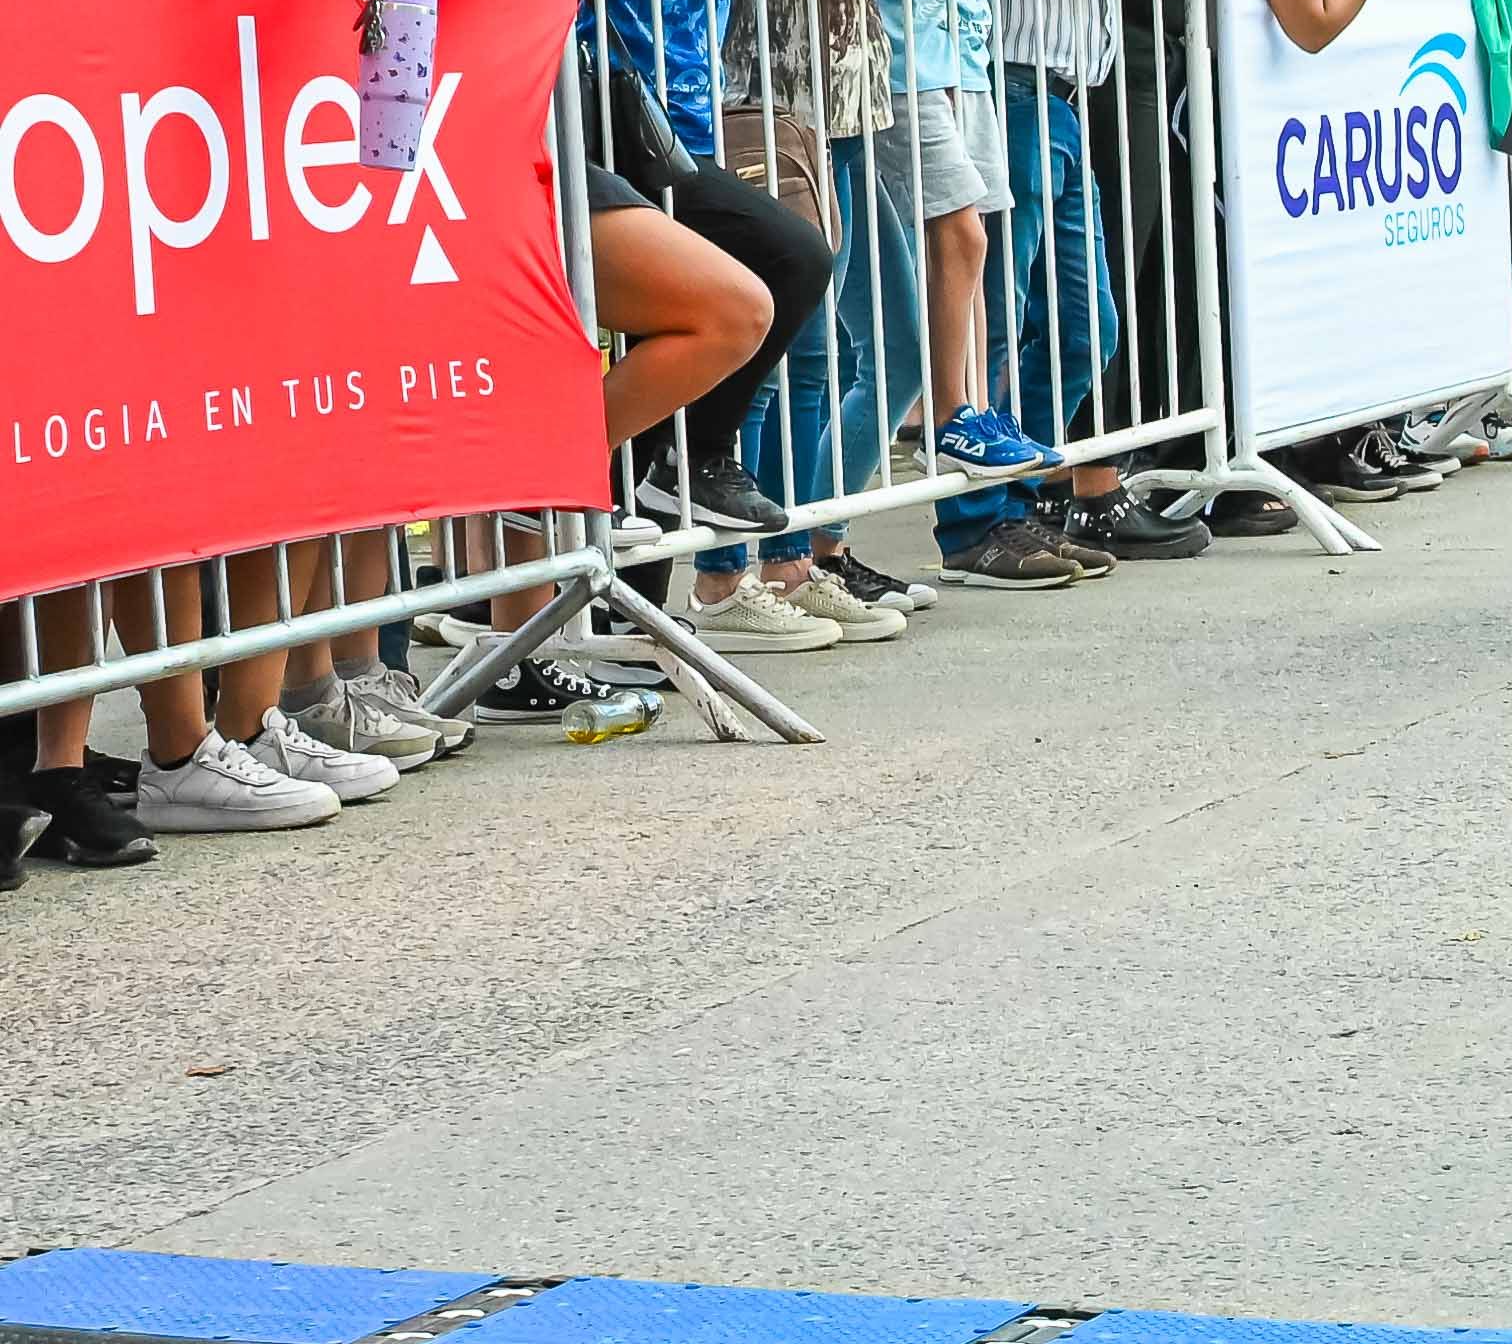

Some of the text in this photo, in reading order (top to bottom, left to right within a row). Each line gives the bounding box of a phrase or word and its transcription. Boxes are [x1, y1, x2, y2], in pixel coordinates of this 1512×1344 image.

[0, 15, 467, 316] oplex
[1276, 102, 1463, 218] CARUSO
[1384, 205, 1465, 247] SEGUROS
[14, 357, 497, 464] LOGIA EN TUS PIES
[941, 433, 986, 457] FILA
